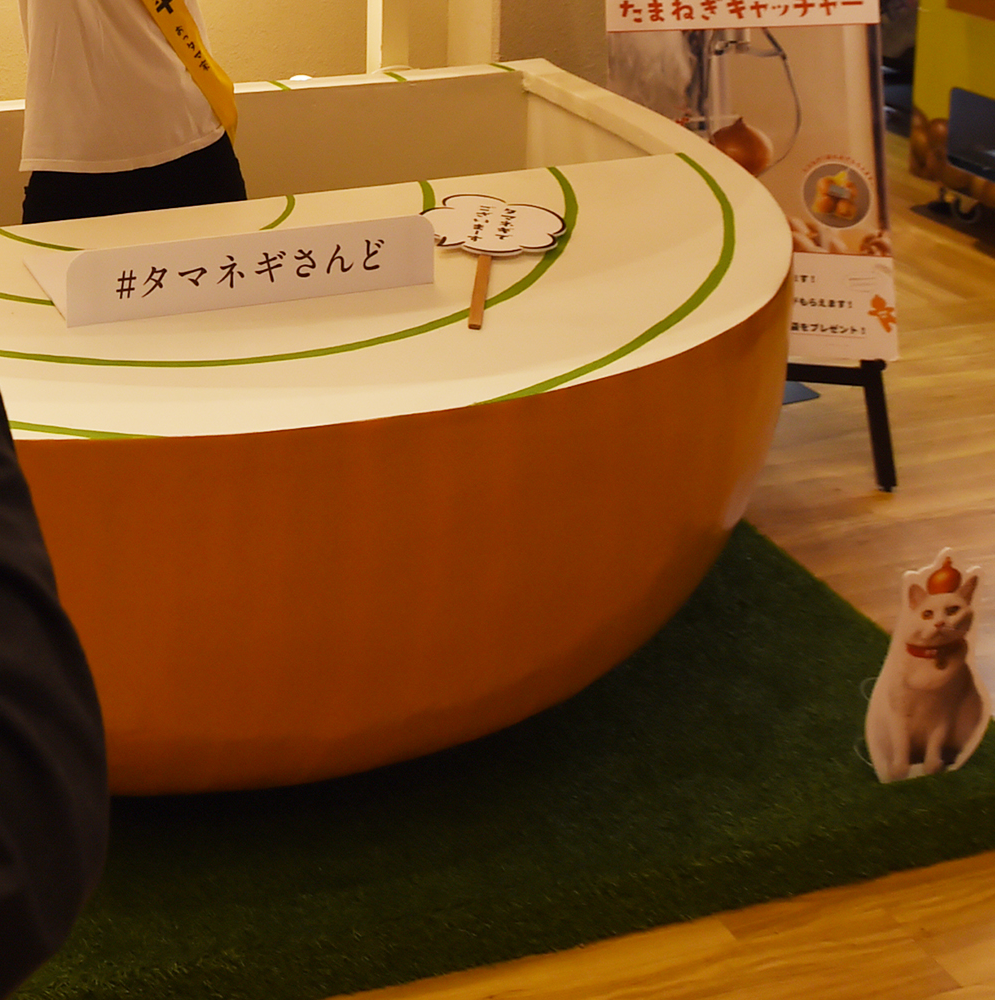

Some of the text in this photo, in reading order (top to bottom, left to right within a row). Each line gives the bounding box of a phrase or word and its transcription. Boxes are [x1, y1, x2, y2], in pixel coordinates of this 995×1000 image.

[115, 237, 386, 300] #タマネギさんど
[793, 297, 853, 309] もらえます！
